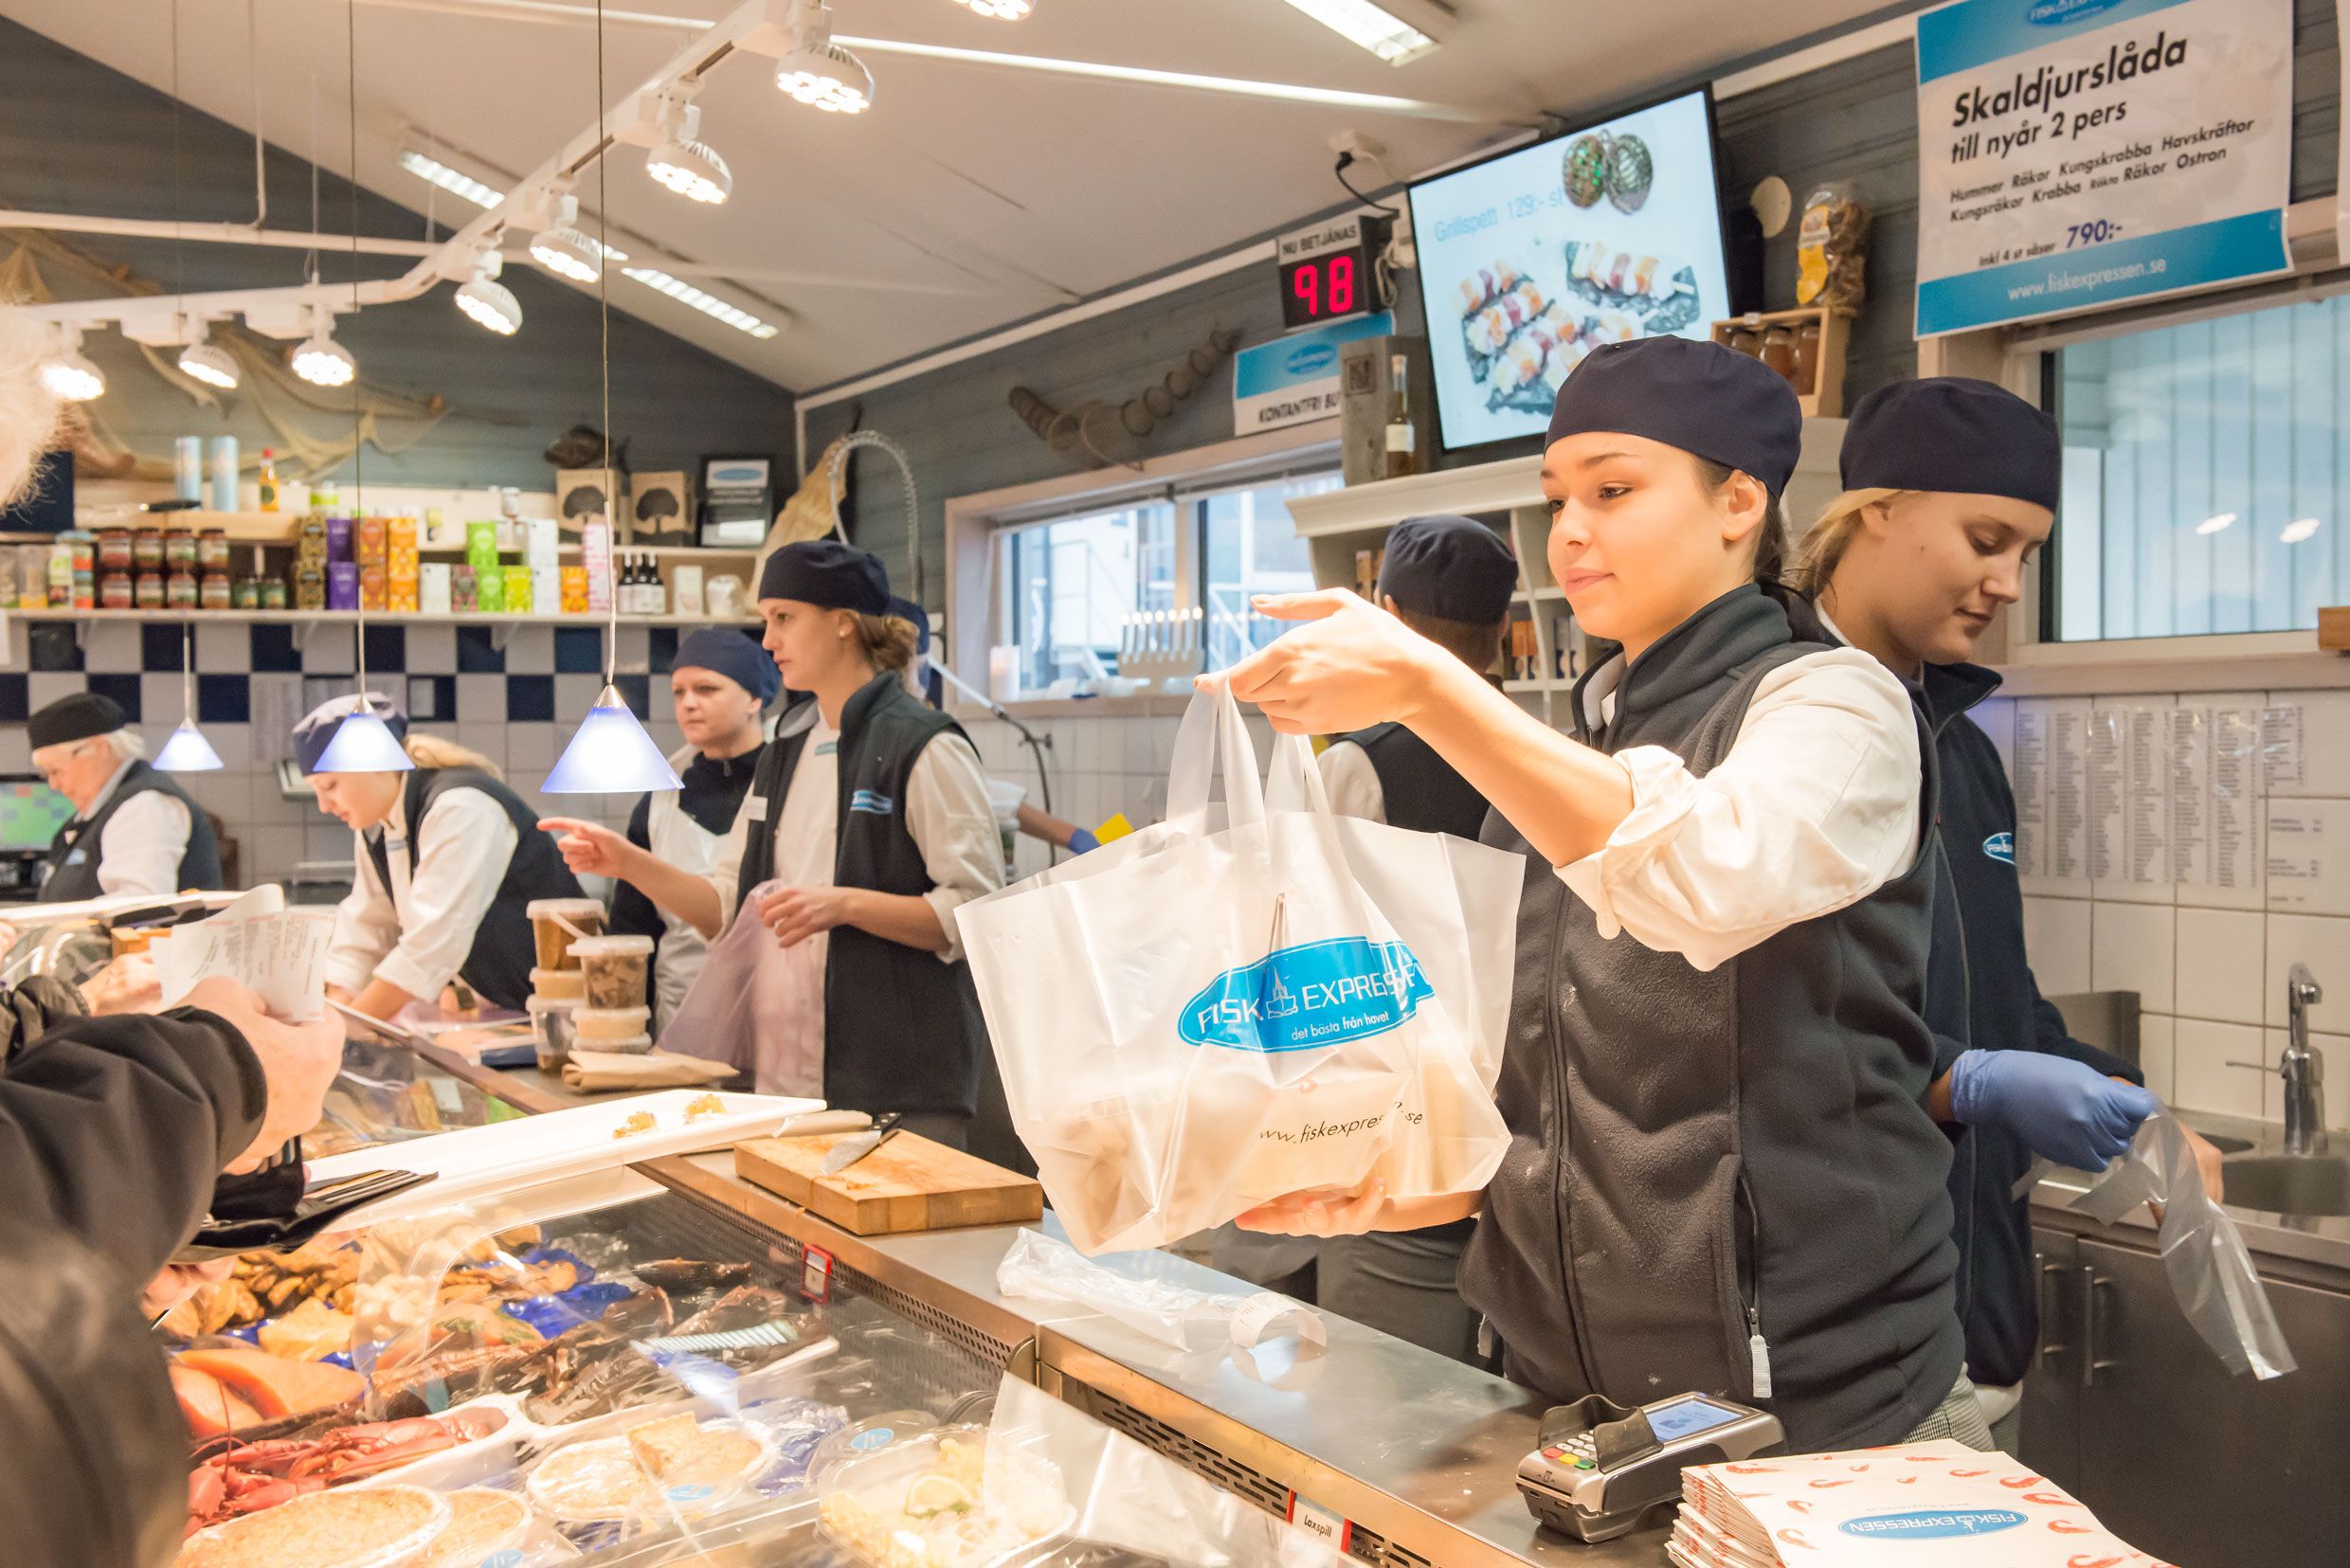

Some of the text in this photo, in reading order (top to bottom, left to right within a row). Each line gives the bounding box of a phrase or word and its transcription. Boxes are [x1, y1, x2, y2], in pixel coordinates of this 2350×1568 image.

[1952, 31, 2188, 128] Skaldjurslåda
[1951, 100, 2127, 164] till nyår 2 pers
[1950, 181, 2004, 203] Hummer
[2059, 143, 2153, 175] Kungskrabba
[2161, 118, 2255, 152] Havskräftor
[1950, 194, 2025, 223] Kungsräkor
[2032, 180, 2082, 203] Krabba
[2124, 161, 2168, 183] Räkor
[2177, 148, 2227, 170] Ostron
[1435, 206, 1499, 243] Grillspett
[2002, 249, 2010, 261] 4
[2066, 219, 2124, 249] 790:-
[1282, 240, 1298, 255] NU
[1293, 255, 1353, 316] 98
[2007, 258, 2167, 301] www.fiskexpressen.se
[1197, 997, 1264, 1035] FISK
[1291, 1010, 1390, 1041] det bästa från havet
[1304, 1514, 1332, 1538] Laxspill
[1849, 1513, 2017, 1533] FISK EXPRESSEN
